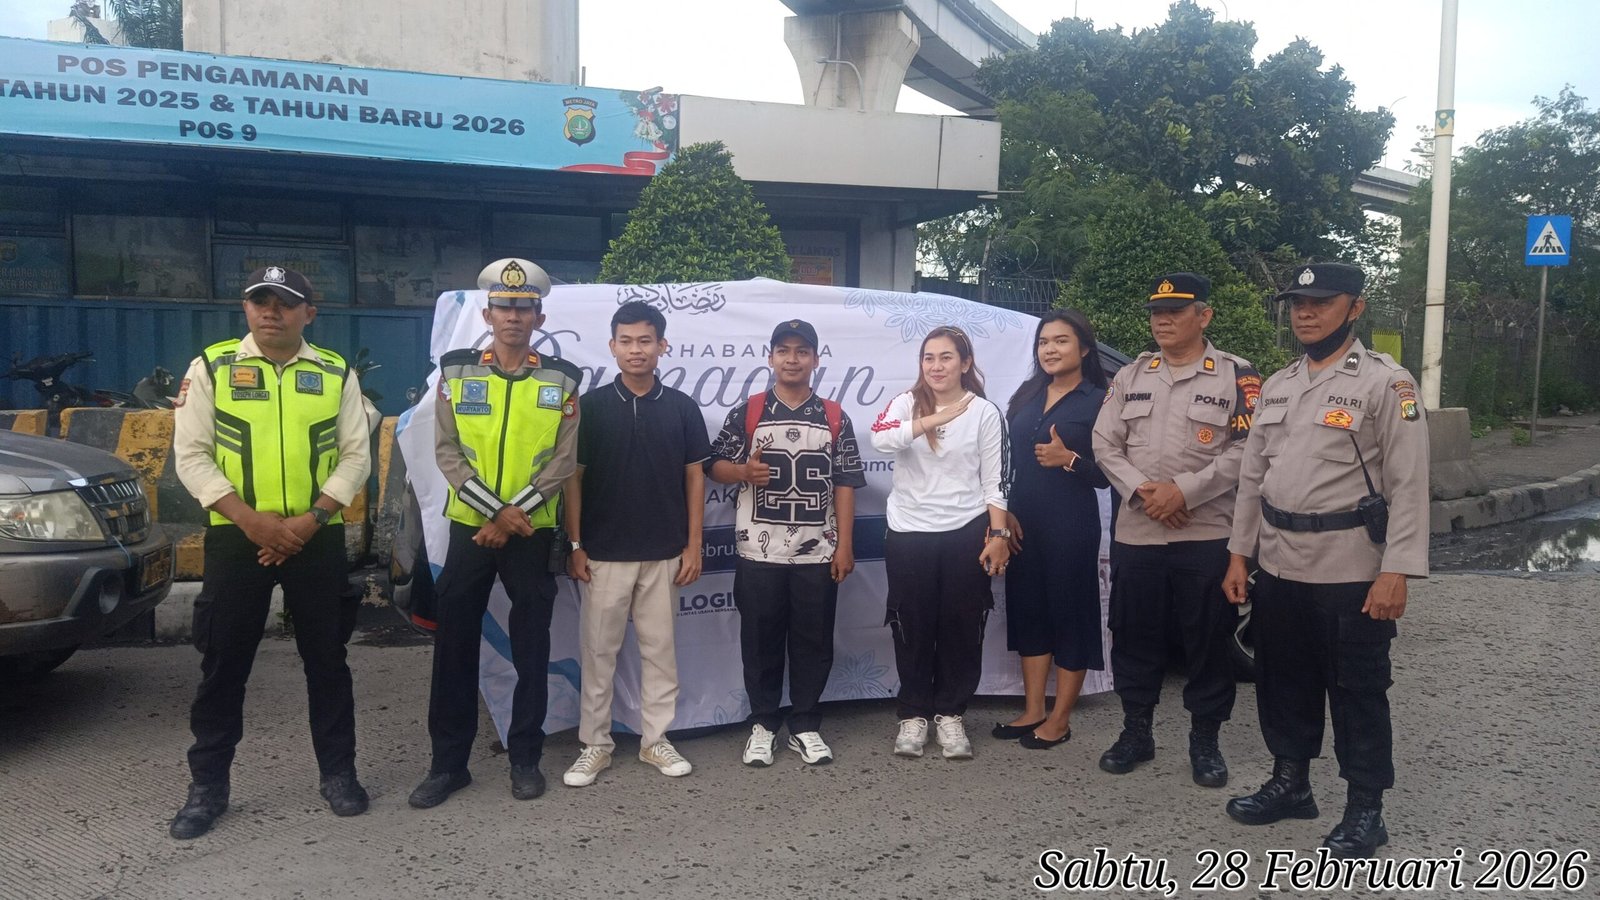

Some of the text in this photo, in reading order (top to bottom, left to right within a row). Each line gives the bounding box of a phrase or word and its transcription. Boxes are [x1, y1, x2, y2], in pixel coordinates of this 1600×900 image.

[57, 54, 369, 96] POS PENGAMANAN
[0, 79, 526, 136] TAHUN 2025 & TAHUN BARU 2026
[179, 119, 257, 142] POS 9
[457, 404, 489, 414] NURYANTO
[1194, 394, 1230, 409] POLRI
[1327, 395, 1362, 409] POLRI
[679, 591, 733, 612] LOGI
